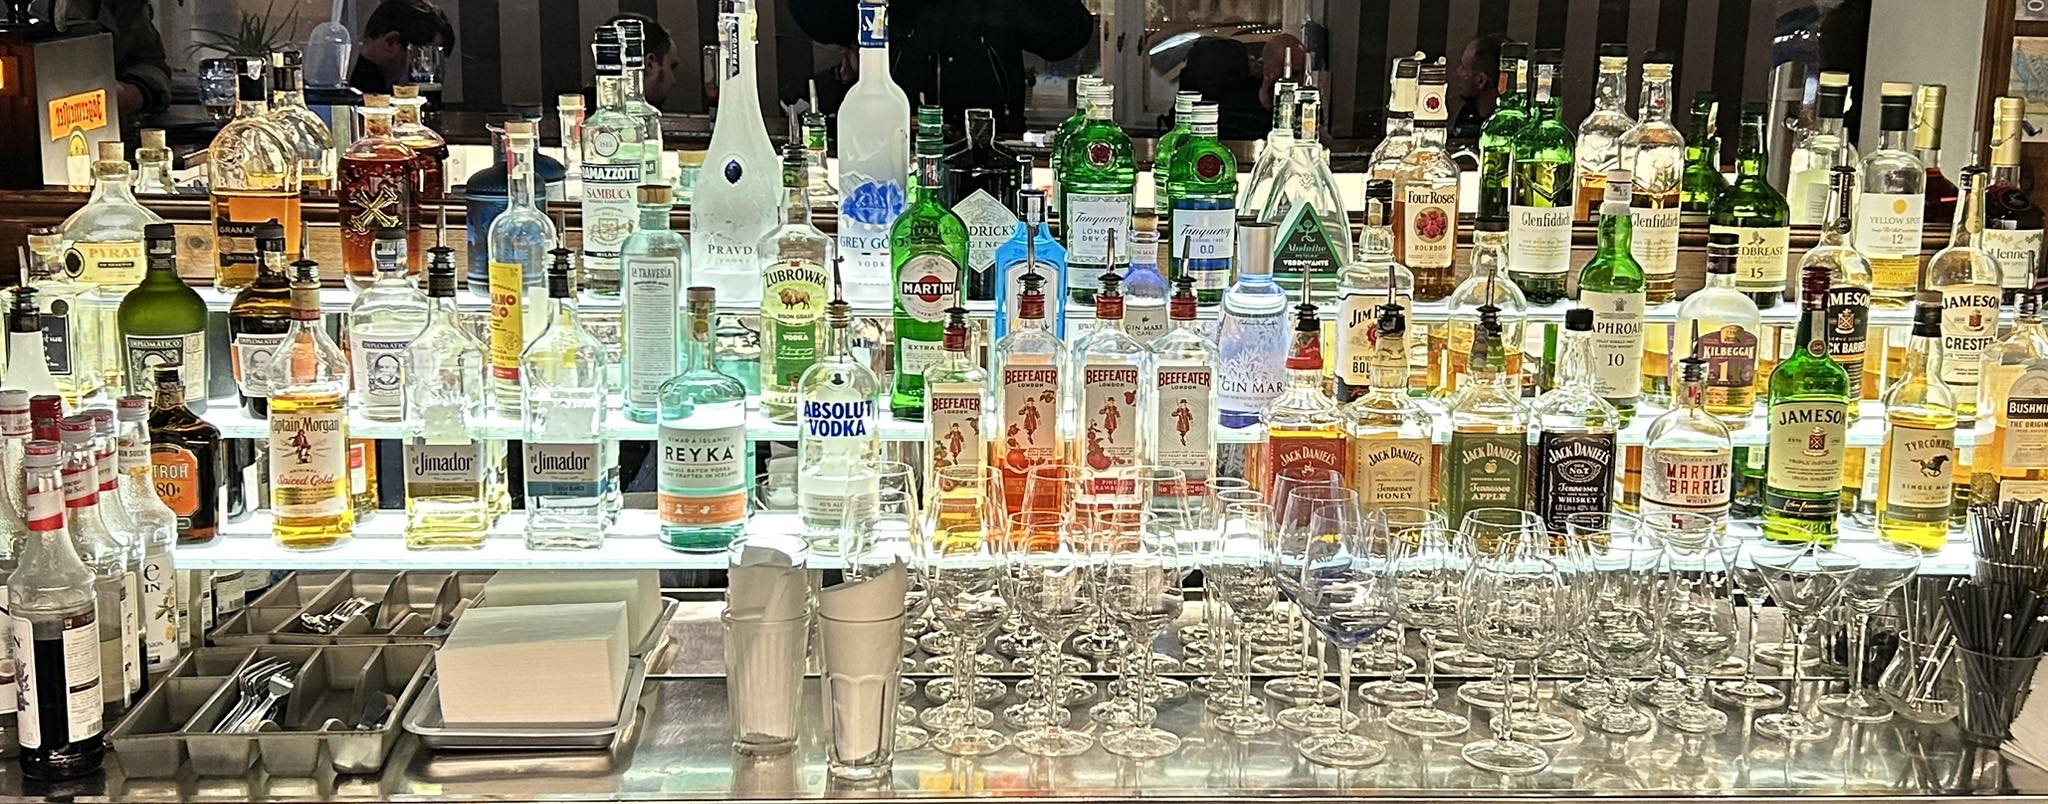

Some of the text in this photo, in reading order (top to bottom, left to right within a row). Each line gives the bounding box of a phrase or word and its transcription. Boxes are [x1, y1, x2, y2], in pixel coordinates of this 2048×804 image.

[586, 188, 631, 199] SAMBUCA
[1408, 191, 1455, 204] Four Roses
[1074, 211, 1125, 226] Tanqueray
[1869, 216, 1904, 224] YELLOW
[219, 226, 243, 234] GRAN
[969, 225, 1015, 237] DRICK'S
[1181, 224, 1231, 237] Tanqueray
[840, 236, 867, 249] GREY
[1892, 234, 1904, 244] 12
[89, 247, 140, 258] PYRAT
[708, 244, 752, 255] PRAVD
[1200, 244, 1214, 254] 0.0
[1741, 246, 1784, 256] DBREAST
[1751, 267, 1764, 279] 15
[1829, 291, 1870, 309] MESON
[1349, 307, 1371, 328] JIM
[1703, 345, 1756, 360] KILBEGGAN
[1608, 353, 1625, 367] 10
[1005, 369, 1057, 386] BEEFEATER
[1086, 369, 1138, 386] BEEFEATER
[1158, 371, 1210, 388] BEEFEATER
[1222, 380, 1247, 393] GIN
[804, 399, 873, 419] ABSOLUT
[932, 397, 980, 413] BEEFEATER
[271, 416, 340, 434] Captain Morgan
[809, 418, 867, 437] VODKA
[665, 446, 732, 462] REYKA
[1280, 446, 1337, 466] JACK DANIEL'S
[1369, 447, 1424, 467] JACK DANIEL'S
[1462, 443, 1522, 465] JACK DANIEL'S
[1549, 441, 1611, 466] JACK DANIEL'S
[416, 452, 474, 476] Jimador
[533, 451, 590, 475] Jimador
[151, 465, 188, 479] TROH
[1667, 463, 1728, 480] MARTIN'S
[277, 473, 335, 486] Spiced Gold
[1377, 483, 1413, 493] Tennessee
[1470, 482, 1511, 492] Tennessee
[1558, 483, 1599, 492] Tennessee
[1669, 480, 1725, 495] BARREL
